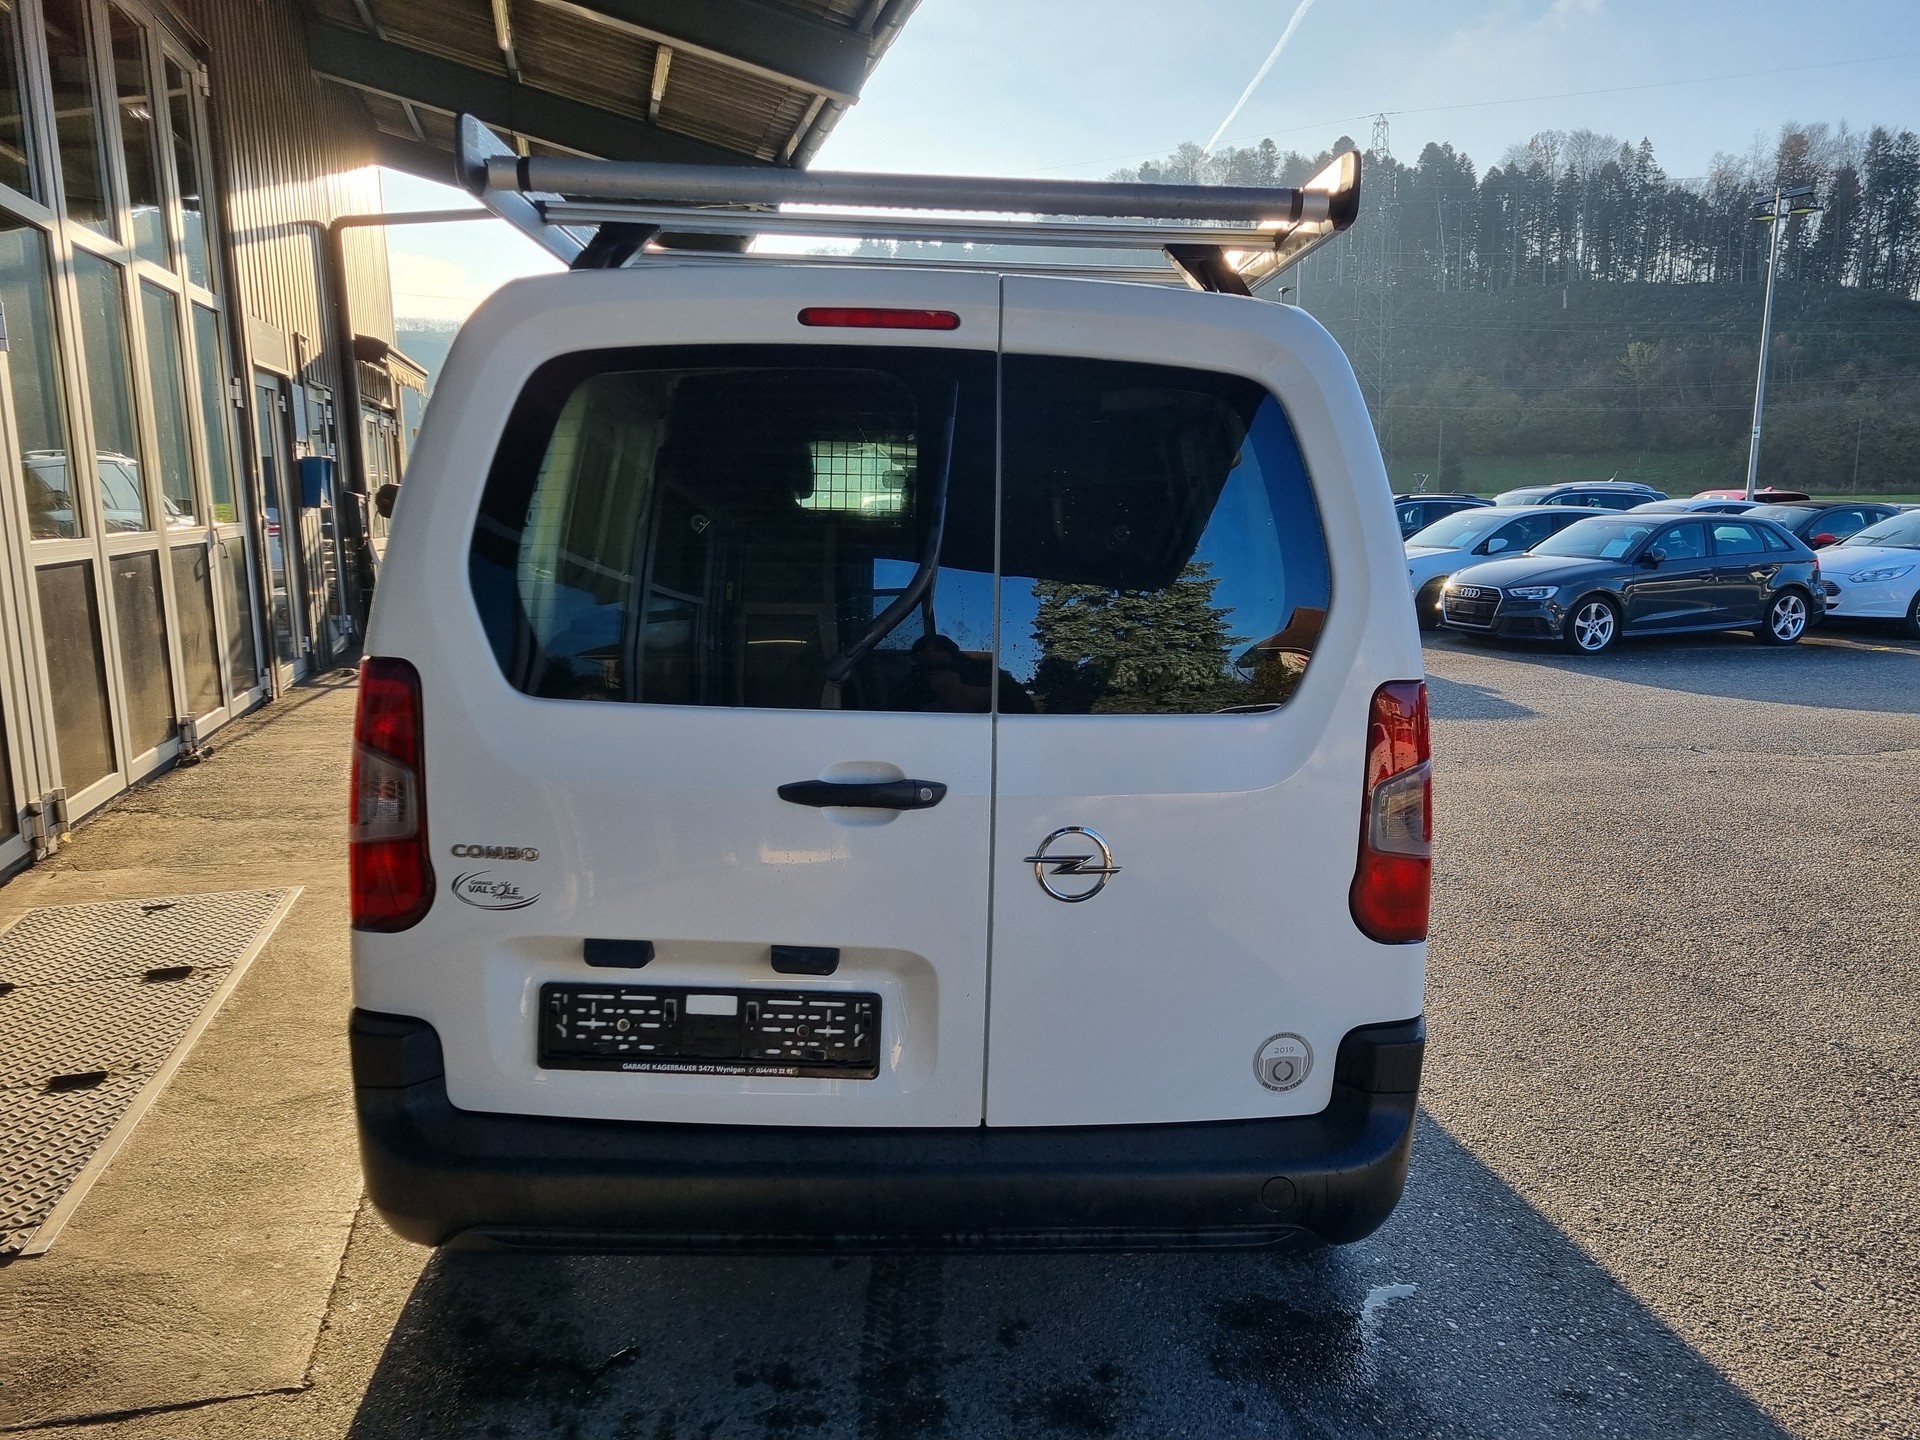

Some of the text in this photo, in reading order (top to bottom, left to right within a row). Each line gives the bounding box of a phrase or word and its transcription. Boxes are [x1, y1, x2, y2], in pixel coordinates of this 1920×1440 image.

[452, 844, 539, 861] COMBO
[468, 884, 520, 896] VALSOLE
[1274, 1046, 1295, 1054] 2019
[622, 1063, 651, 1071] GARAGE
[652, 1064, 697, 1072] KAGERBAUER
[698, 1065, 715, 1073] 3472
[716, 1066, 746, 1074] Wynigen
